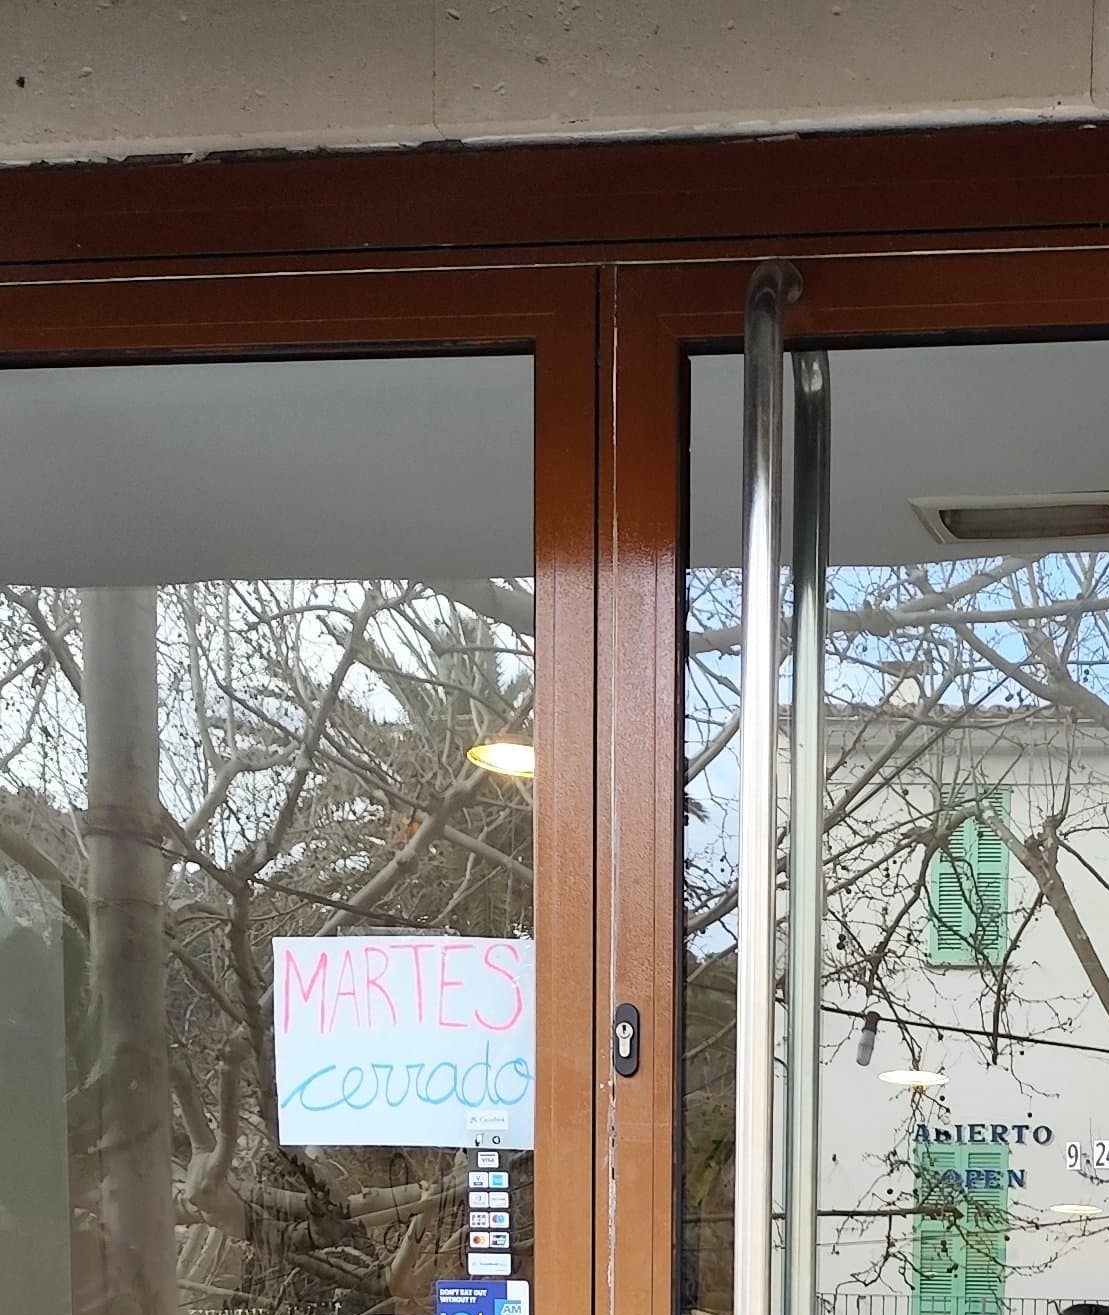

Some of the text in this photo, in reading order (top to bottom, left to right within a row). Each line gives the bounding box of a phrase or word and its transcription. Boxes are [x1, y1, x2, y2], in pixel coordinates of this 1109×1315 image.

[283, 943, 523, 1034] MARTES
[281, 1040, 534, 1111] cerrado
[913, 1123, 1053, 1145] ABIERTO
[1067, 1143, 1079, 1168] 9
[941, 1169, 1026, 1189] OPEN
[503, 1304, 521, 1314] AM
